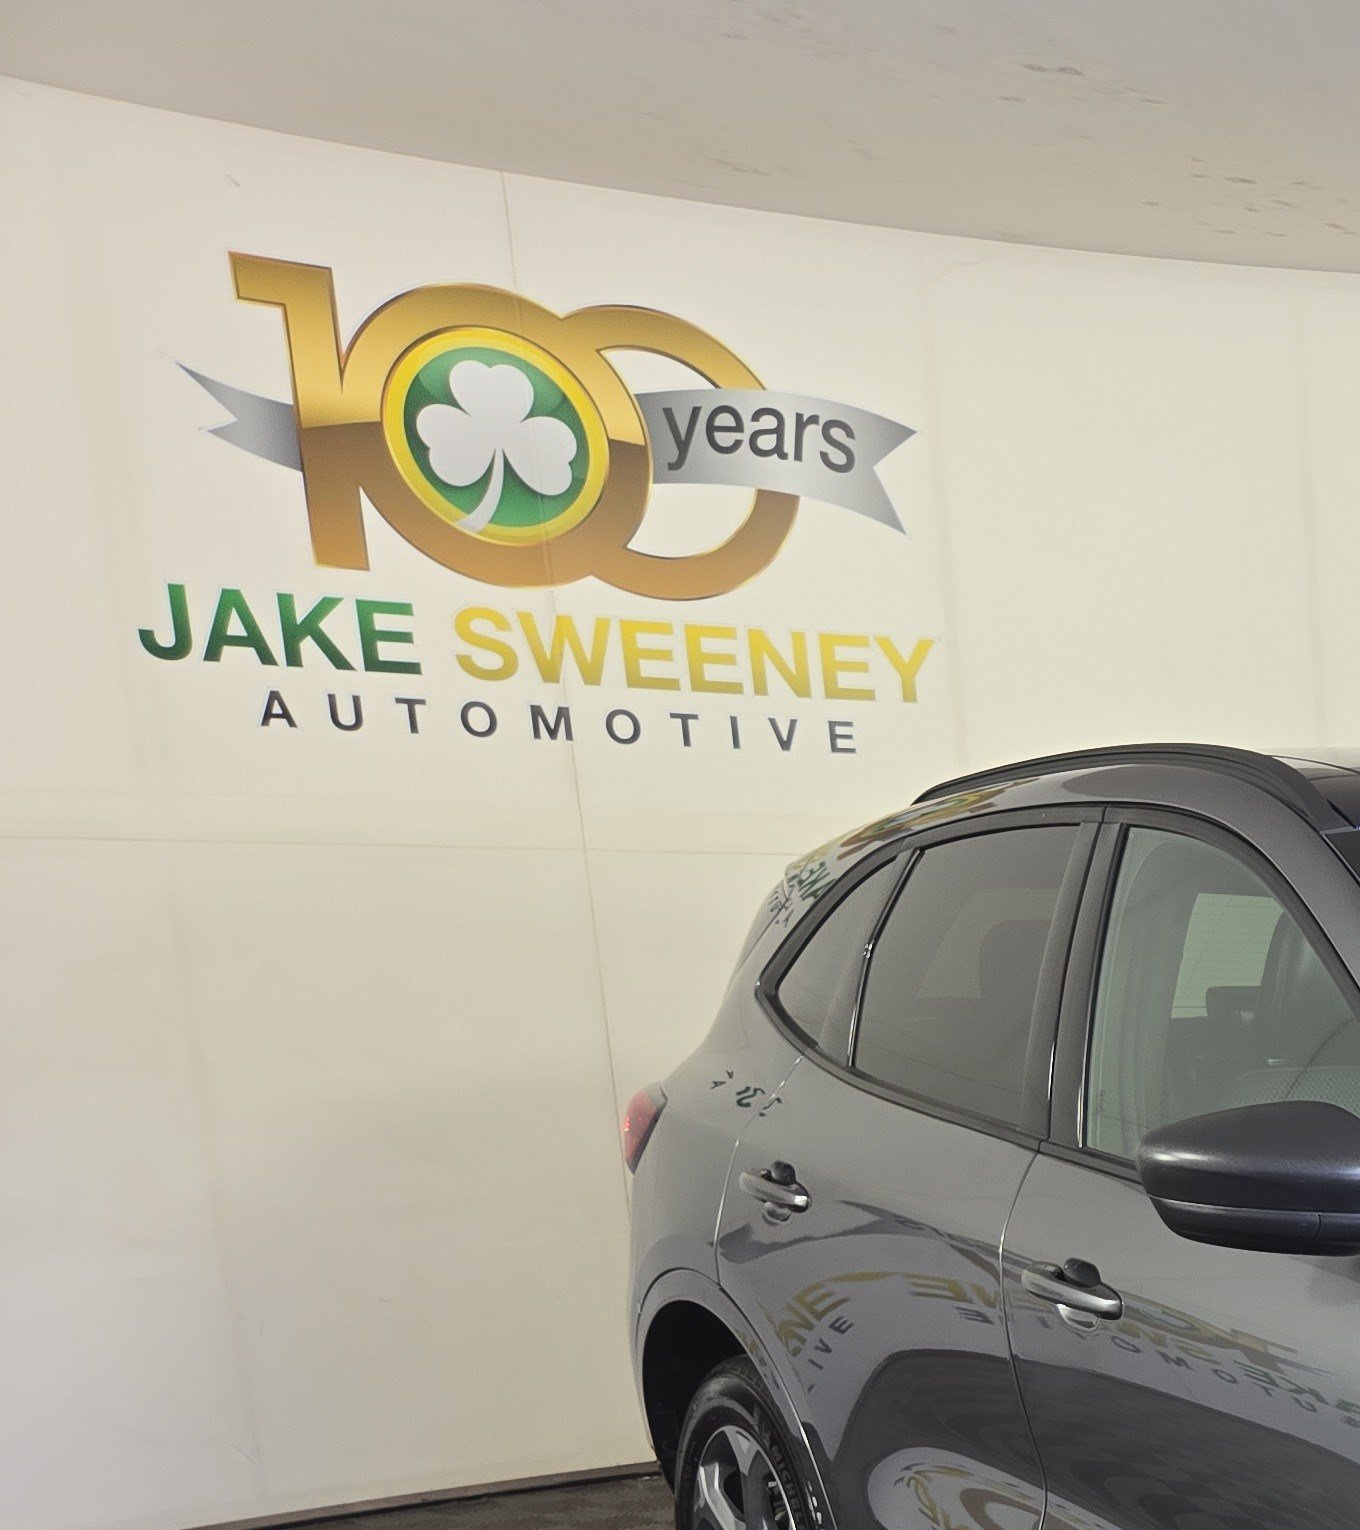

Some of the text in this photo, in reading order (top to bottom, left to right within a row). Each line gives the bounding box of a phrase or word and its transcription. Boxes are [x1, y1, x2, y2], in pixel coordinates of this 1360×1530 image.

[661, 404, 857, 475] years
[137, 582, 934, 703] JAKE SWEENEY
[260, 690, 858, 754] AUTOMOTIVE
